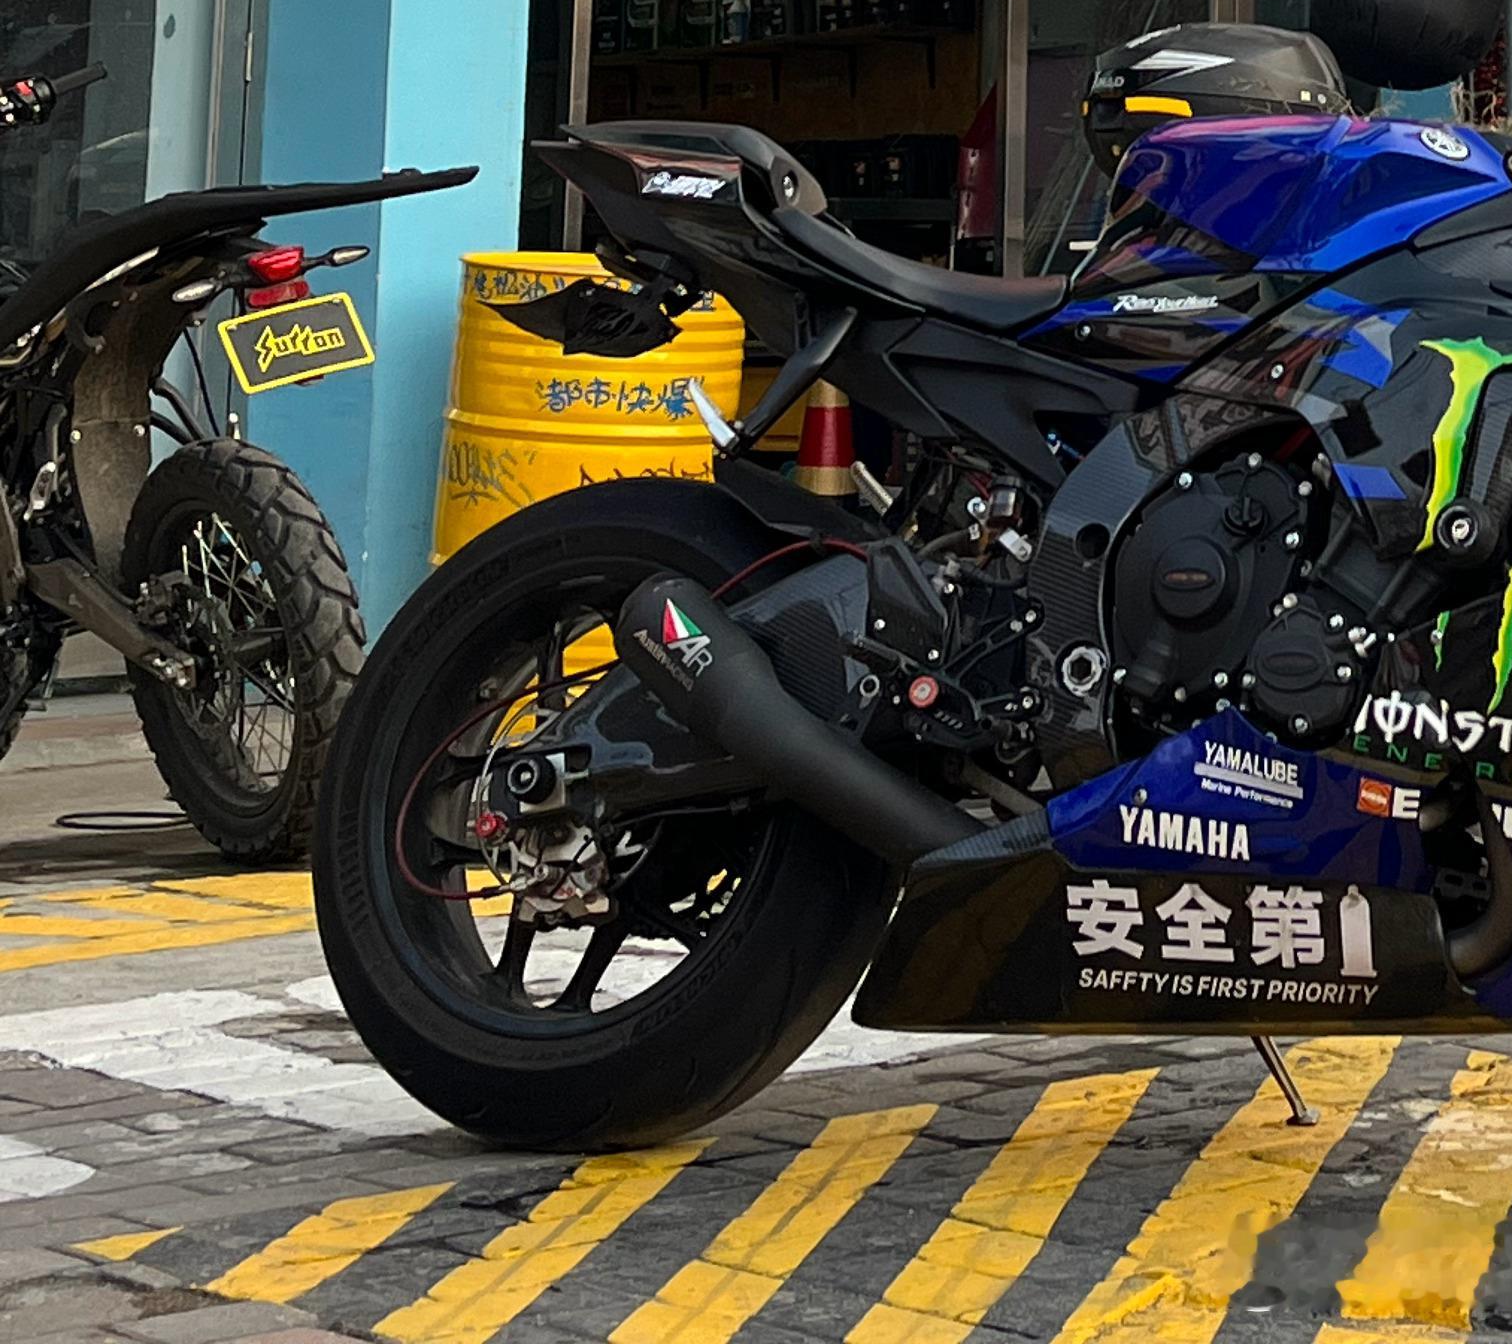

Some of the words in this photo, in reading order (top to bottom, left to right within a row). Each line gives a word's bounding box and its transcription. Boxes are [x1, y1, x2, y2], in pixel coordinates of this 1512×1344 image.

[1205, 740, 1298, 786] YAMALUBE
[1119, 804, 1250, 861] YAMAHA
[1079, 968, 1168, 994] SAFFTY
[1172, 975, 1194, 995] IS
[1197, 976, 1264, 1000] FIRST
[1267, 980, 1378, 1006] PRIORITY
